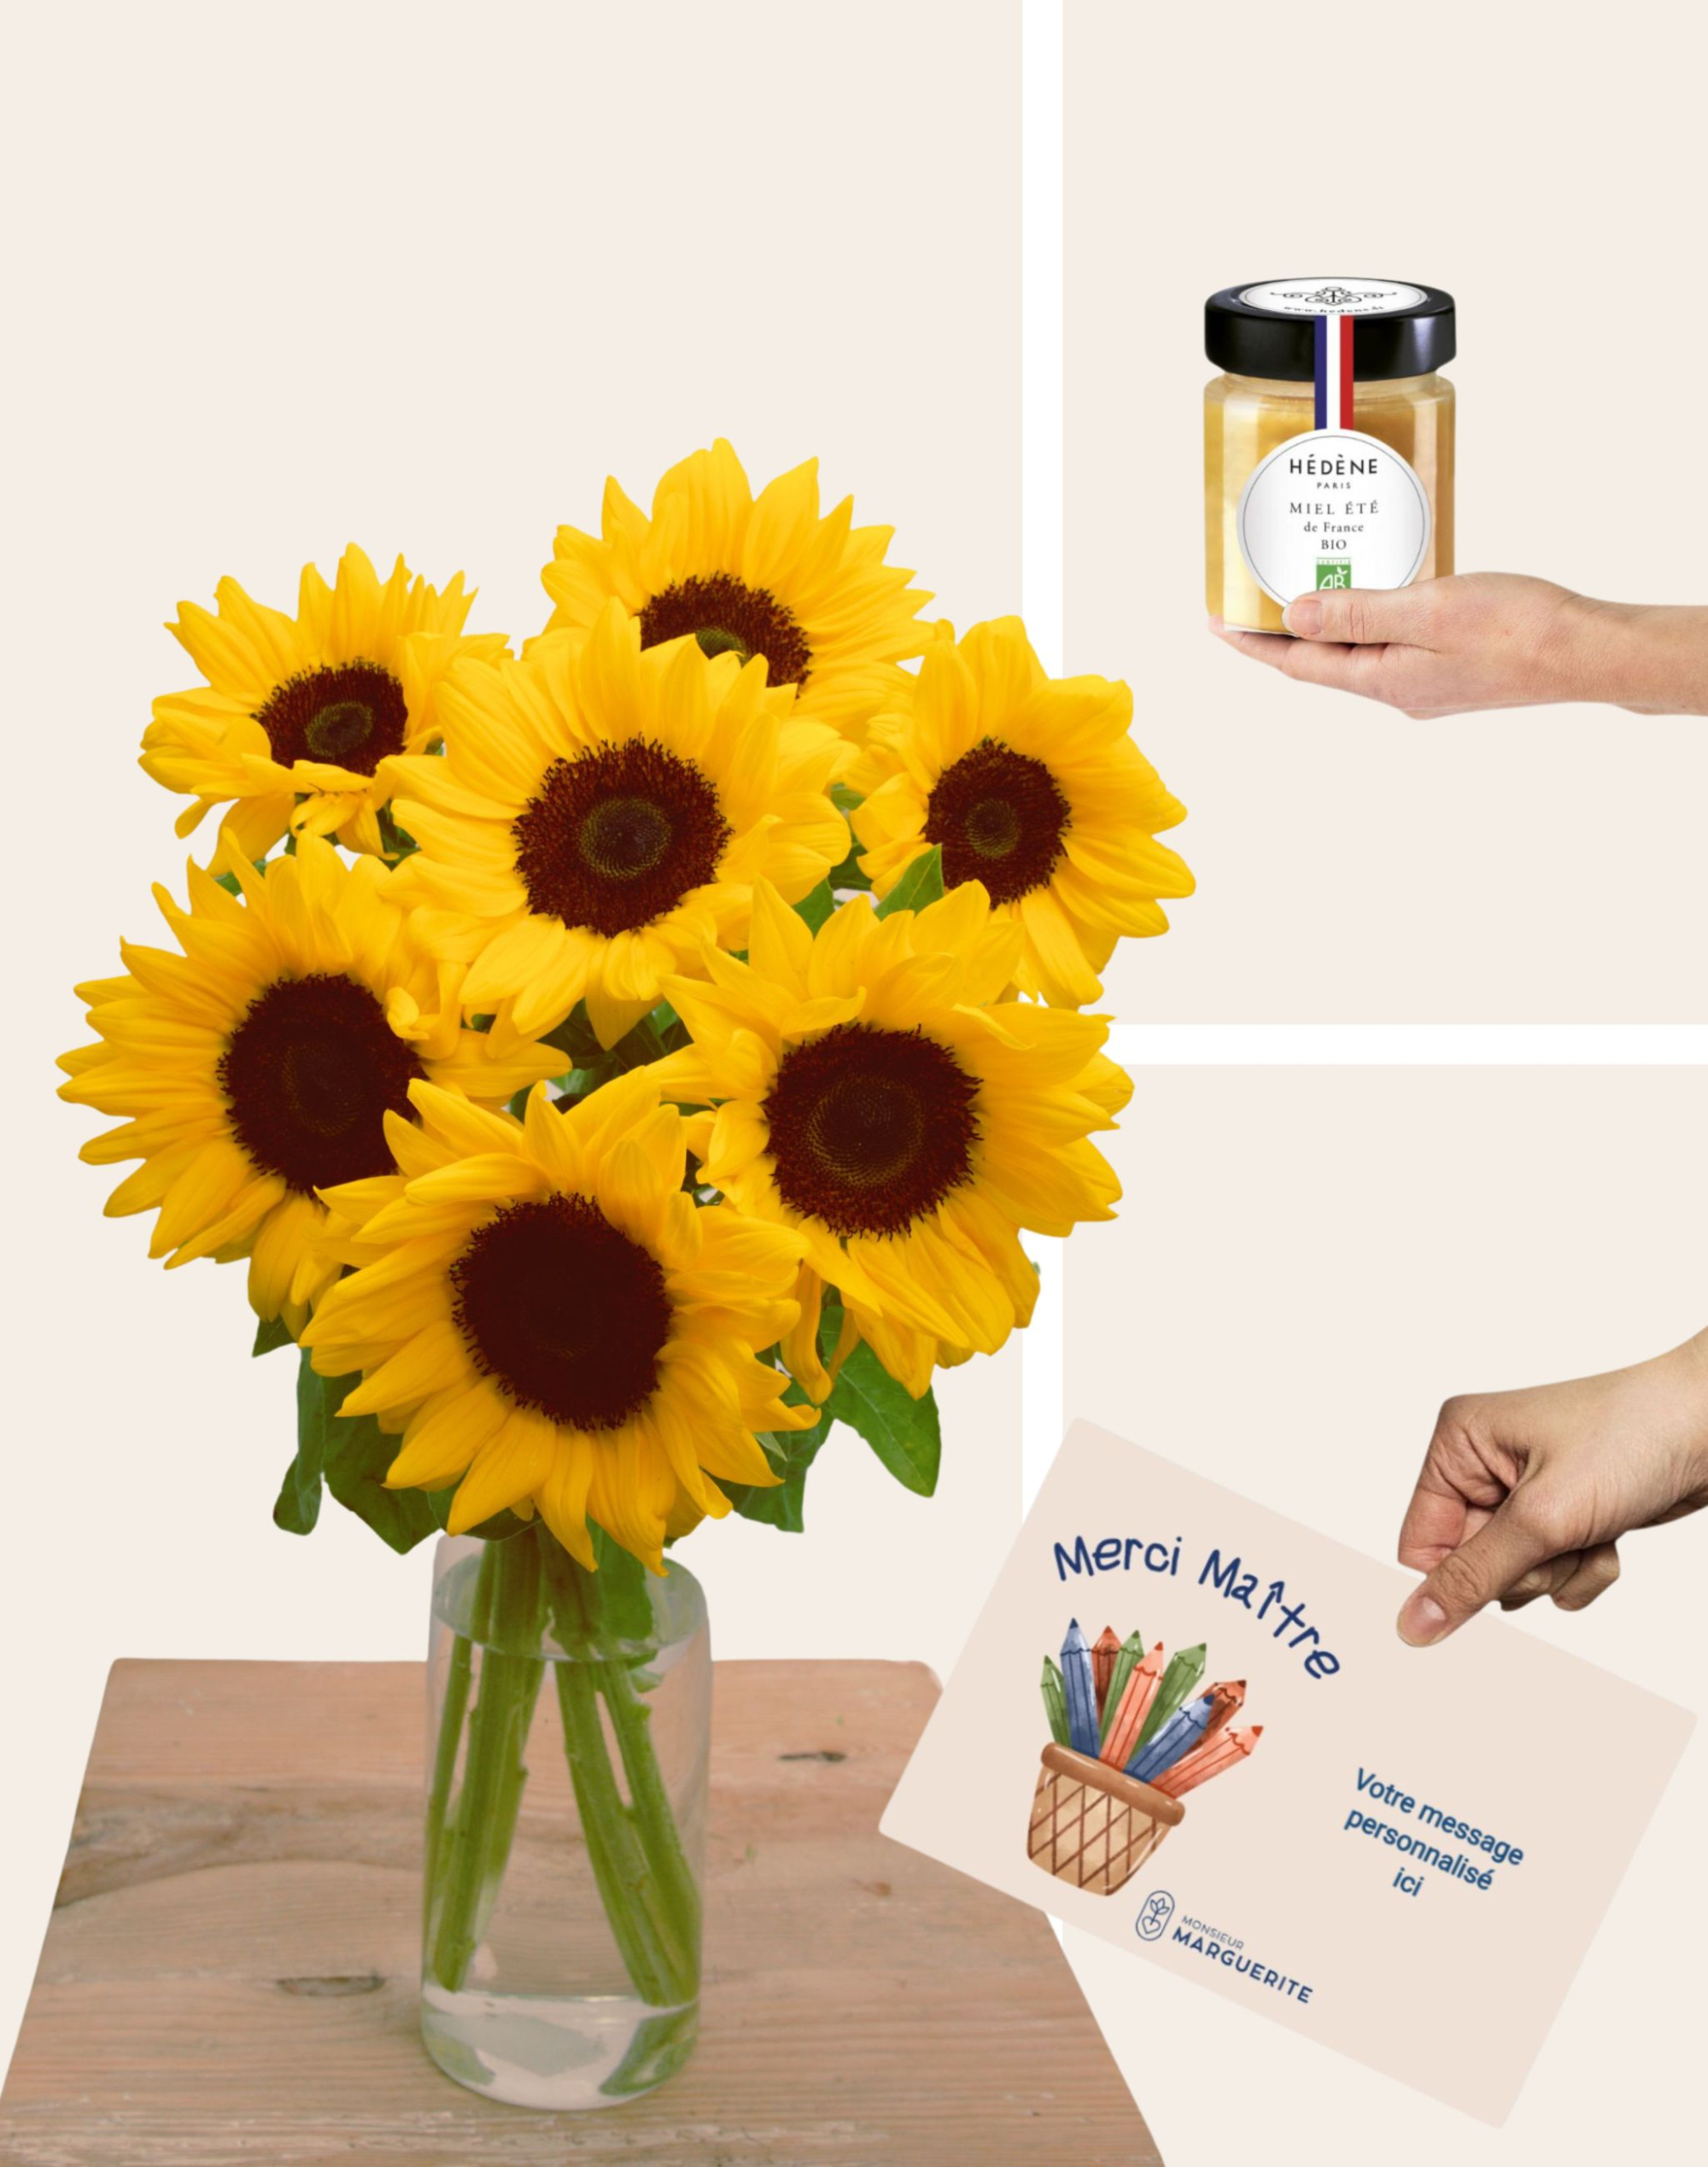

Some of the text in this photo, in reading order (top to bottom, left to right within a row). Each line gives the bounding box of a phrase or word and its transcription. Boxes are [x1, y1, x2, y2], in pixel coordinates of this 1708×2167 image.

[1290, 454, 1378, 475] HÉDÈNE
[1290, 500, 1379, 515] MIEL ÉTÉ
[1303, 522, 1365, 532] de France
[1321, 540, 1347, 550] BIO
[1053, 1535, 1341, 1680] Merci Maître
[1356, 1767, 1524, 1865] Votre message
[1343, 1809, 1496, 1890] personnalisé
[1392, 1866, 1425, 1897] ici
[1181, 1914, 1245, 1951] MONSIEUR
[1172, 1926, 1313, 2004] MARGUERITE
